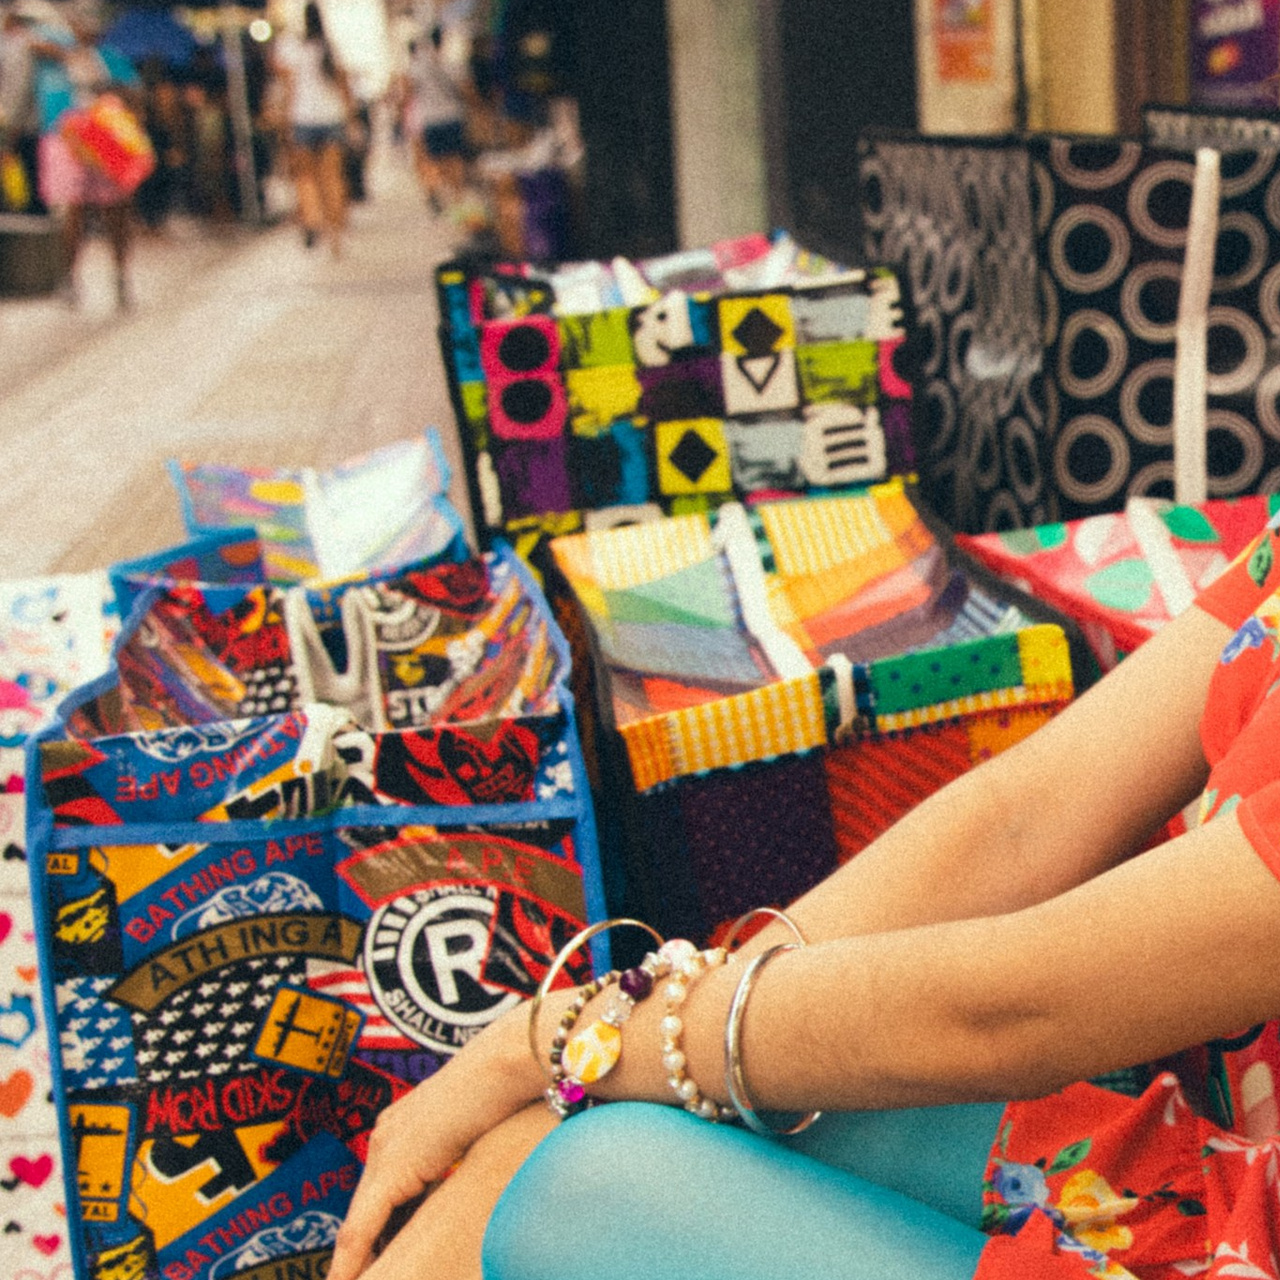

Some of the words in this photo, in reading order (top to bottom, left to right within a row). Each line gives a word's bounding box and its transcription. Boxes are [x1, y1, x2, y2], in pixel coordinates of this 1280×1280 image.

[115, 768, 181, 802] APE
[124, 849, 257, 943] BATHING
[265, 832, 324, 866] APE
[424, 919, 499, 1005] R
[382, 989, 447, 1042] SHALL
[145, 1079, 223, 1133] ROW
[221, 1069, 294, 1122] SKID
[301, 1164, 358, 1205] APE
